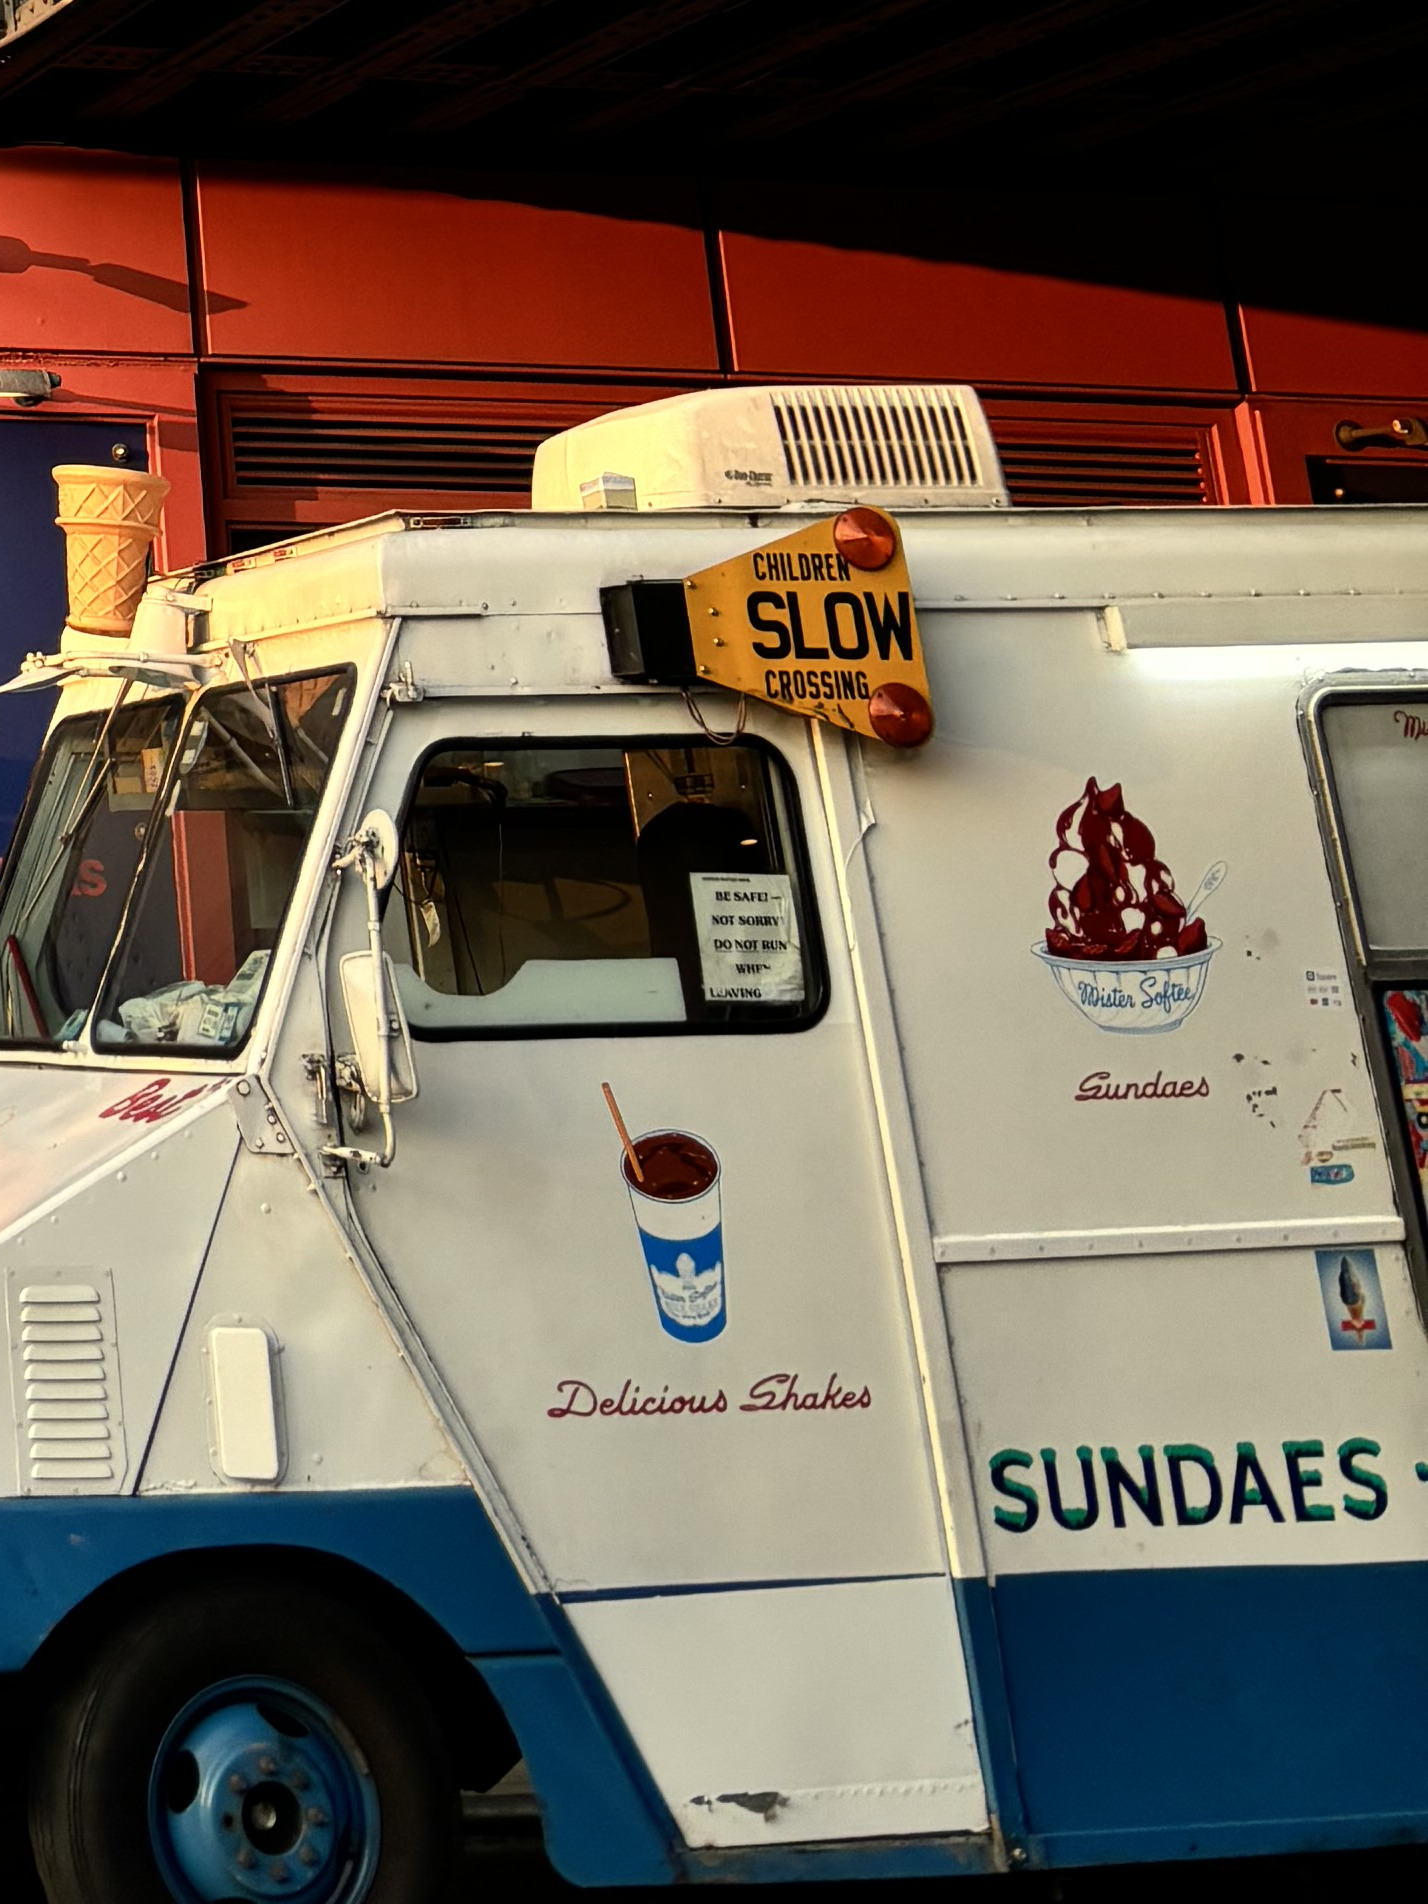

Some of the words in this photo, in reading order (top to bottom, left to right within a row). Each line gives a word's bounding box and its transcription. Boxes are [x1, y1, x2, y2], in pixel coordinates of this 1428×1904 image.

[753, 552, 852, 582] CHILDREN
[746, 590, 914, 661] SLOW
[764, 670, 870, 700] CROSSING
[712, 915, 735, 926] NOT
[714, 938, 732, 950] DO
[734, 939, 759, 951] NOT
[761, 940, 788, 951] RUN
[1078, 980, 1136, 1010] Mister
[1140, 976, 1194, 1013] Softee
[1074, 1070, 1210, 1102] Sundaes
[547, 1378, 728, 1418] Delicious
[739, 1372, 873, 1412] Shakes
[988, 1436, 1389, 1533] SUNDAES
